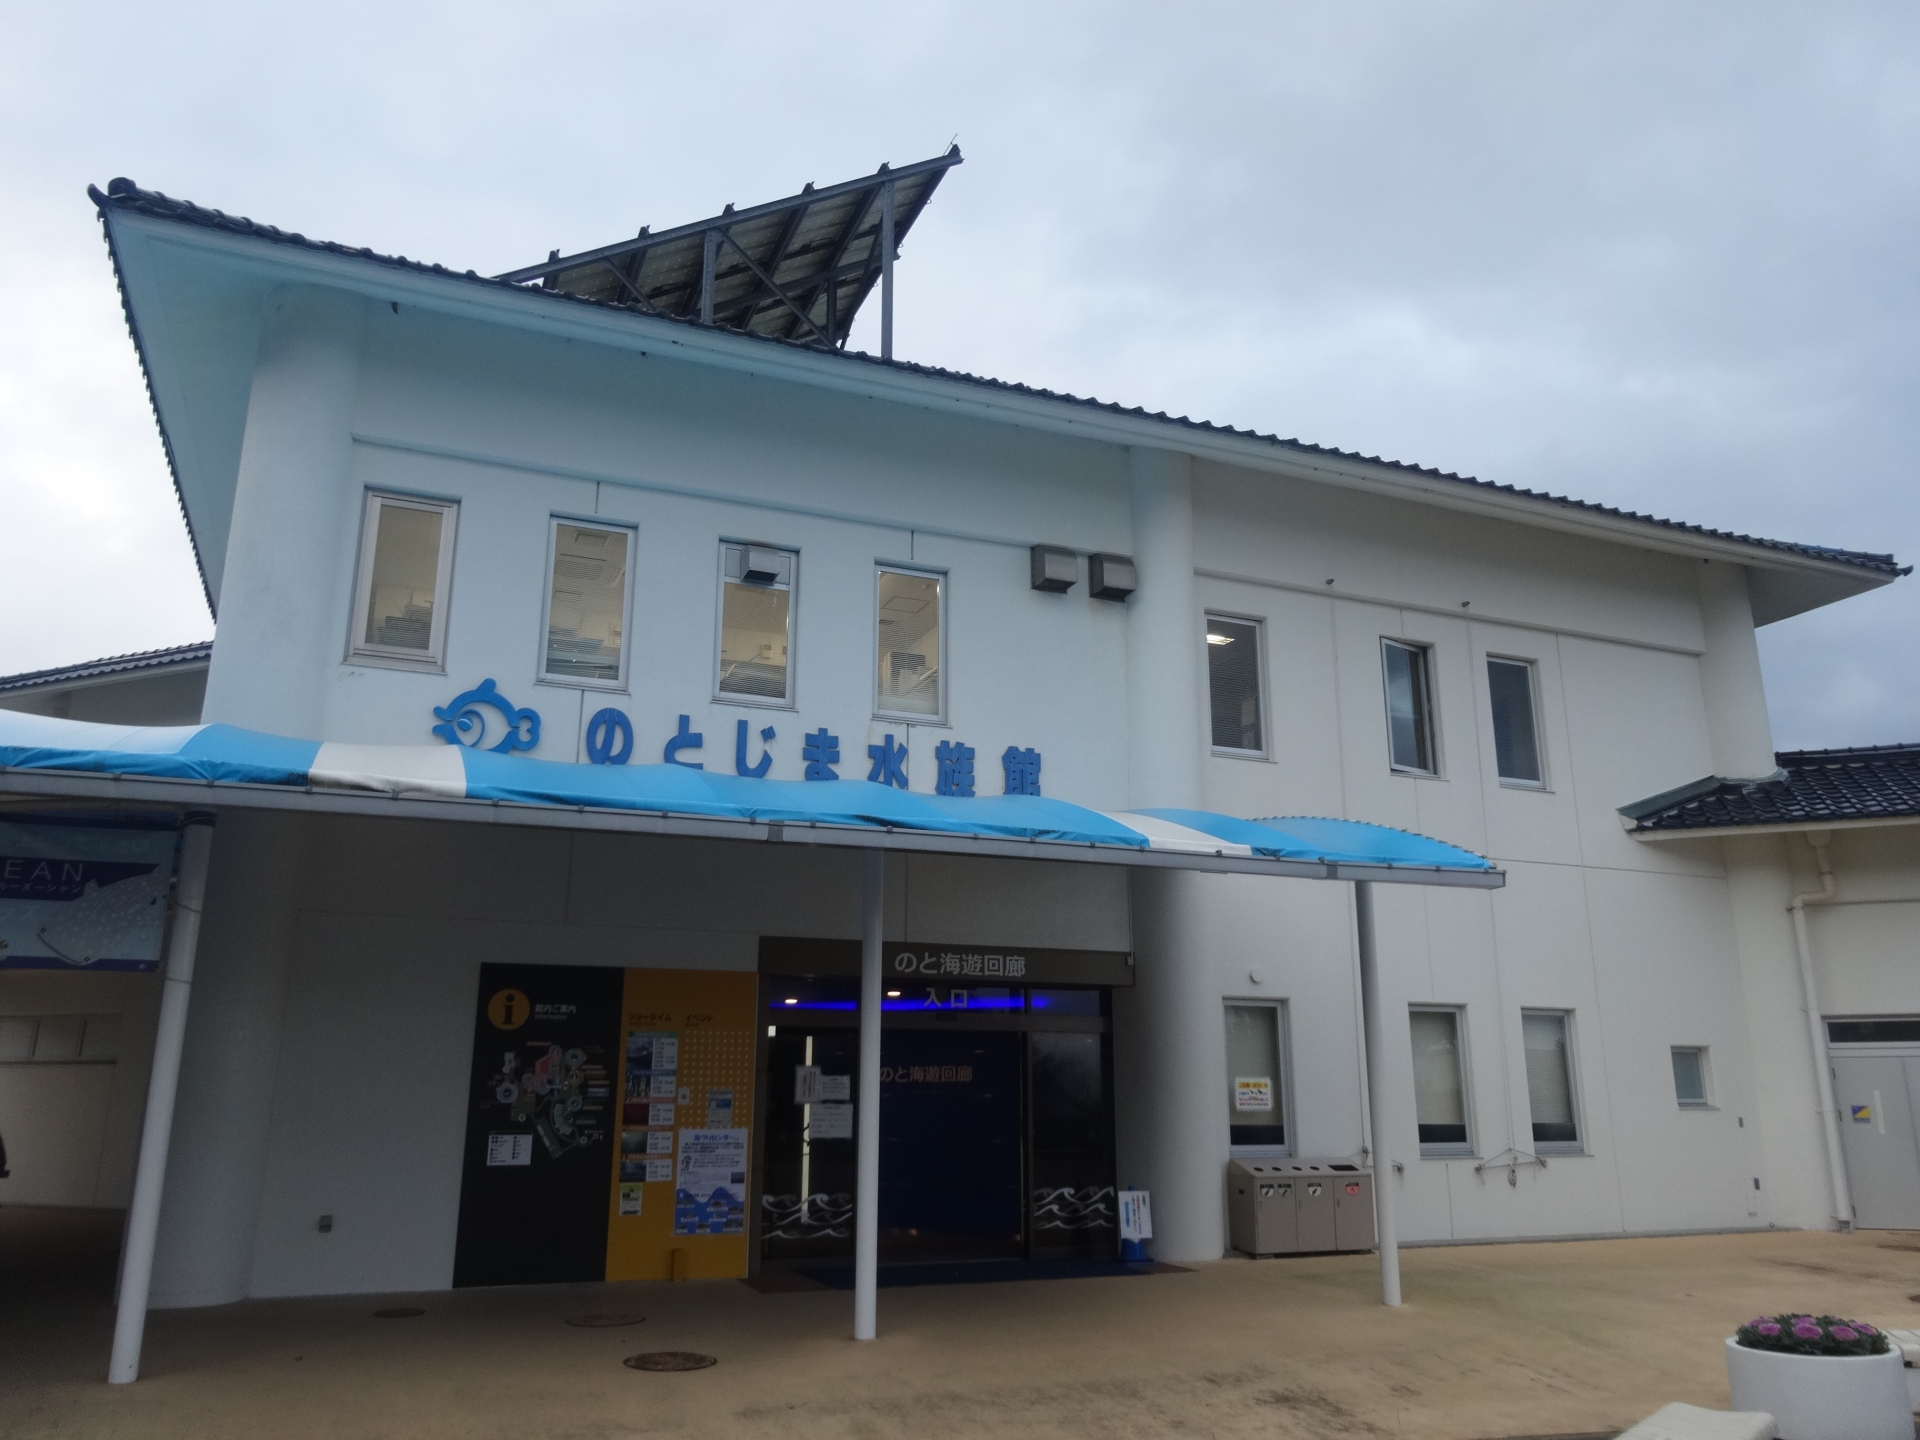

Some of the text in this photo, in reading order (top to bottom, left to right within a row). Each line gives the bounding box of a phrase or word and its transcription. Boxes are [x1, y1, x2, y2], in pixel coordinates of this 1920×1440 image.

[586, 707, 1041, 797] のとじま水族館
[894, 952, 1026, 978] のと海遊回廊
[923, 987, 968, 1008] 入口
[880, 1065, 973, 1083] のと海遊回廊
